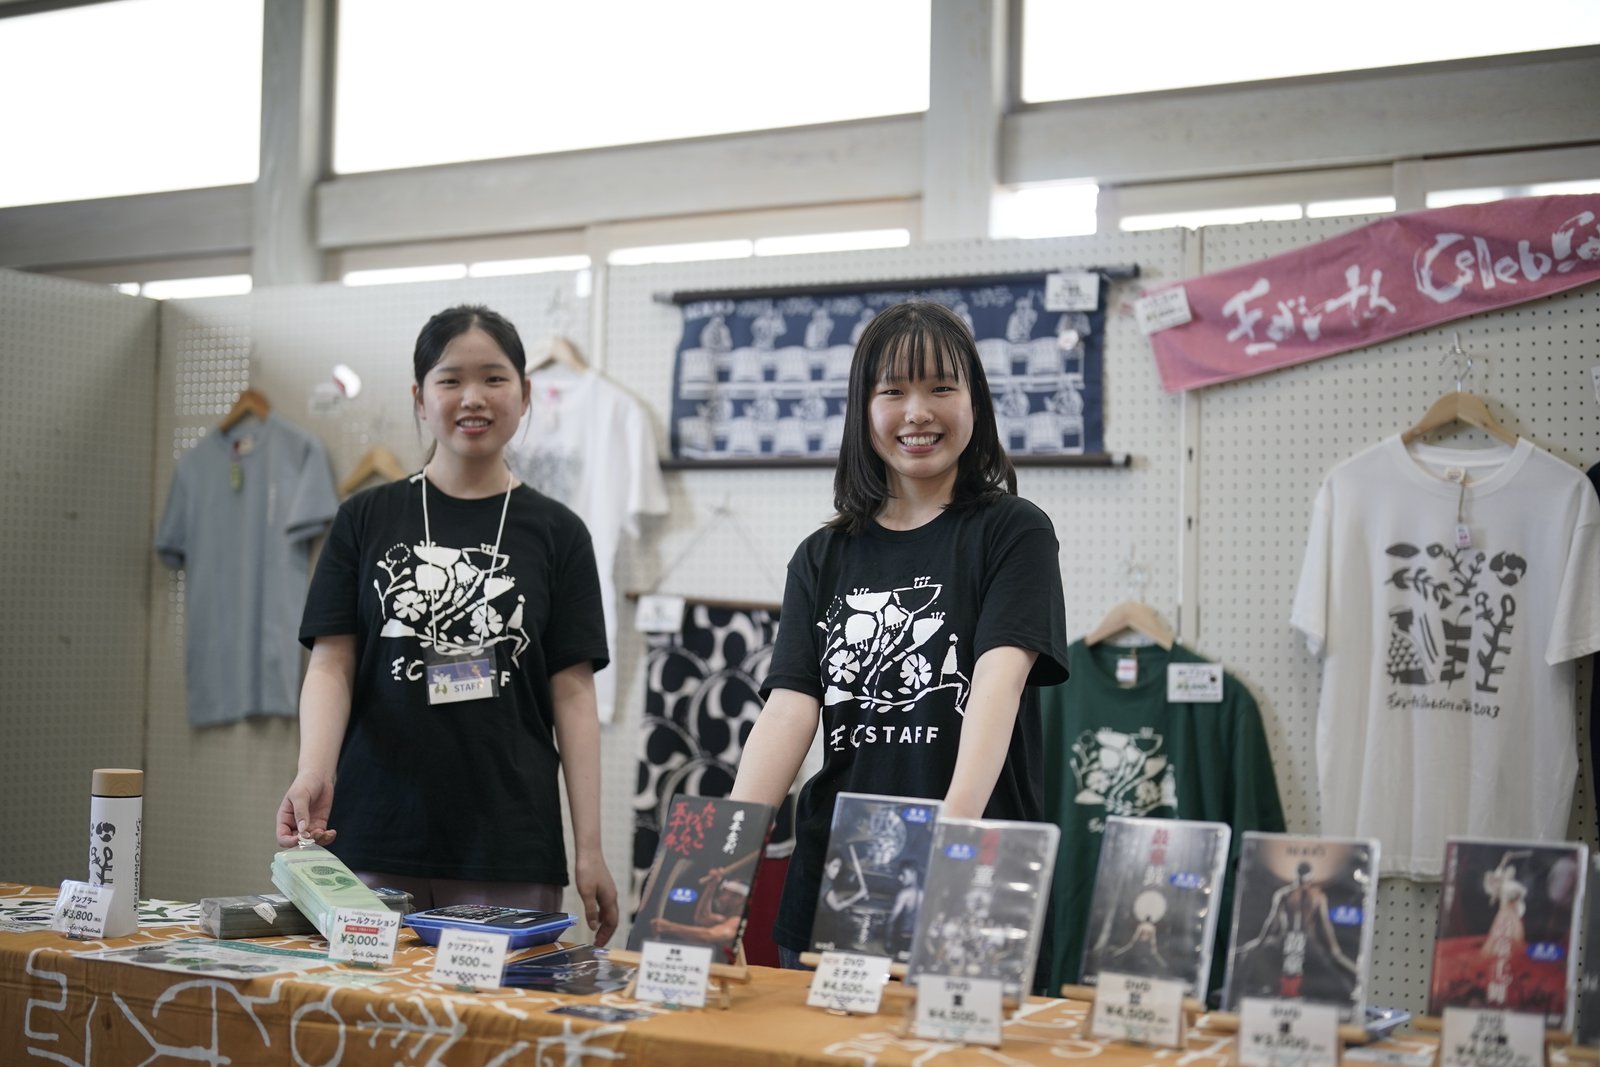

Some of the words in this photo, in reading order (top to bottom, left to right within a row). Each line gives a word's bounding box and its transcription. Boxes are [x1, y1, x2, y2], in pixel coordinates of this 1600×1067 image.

[1221, 264, 1397, 357] Earth
[1412, 209, 1600, 304] Celebra
[864, 725, 939, 744] STAFF
[70, 895, 98, 905] タンブラー
[62, 908, 93, 922] ¥3,800
[337, 914, 397, 927] トレールクッション
[340, 933, 378, 947] ¥3,000
[447, 942, 494, 954] クリアファイル
[450, 954, 480, 968] ¥500
[842, 957, 866, 967] DVD
[646, 971, 686, 985] ¥2,200
[822, 981, 863, 994] ¥4,500
[944, 981, 972, 993] DVD
[1124, 979, 1152, 993] DVD
[928, 1008, 978, 1024] ¥4,500
[1105, 1004, 1156, 1023] ¥4,500
